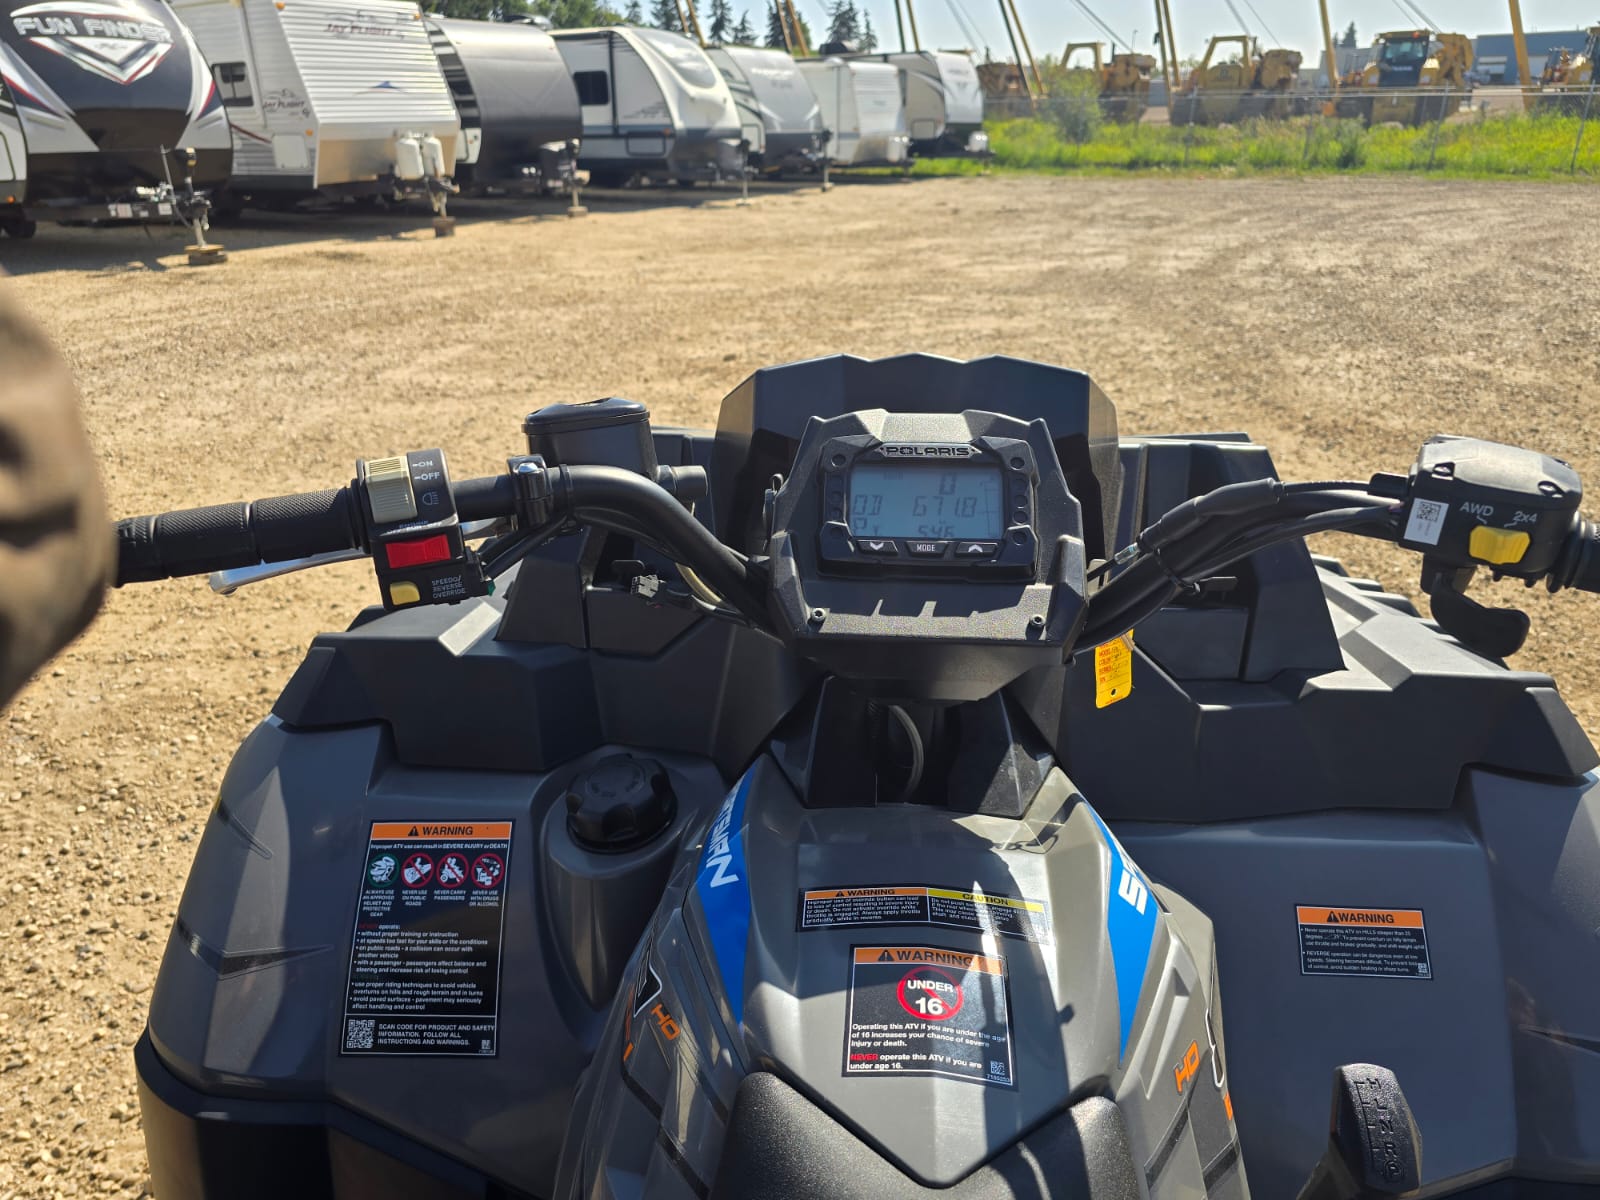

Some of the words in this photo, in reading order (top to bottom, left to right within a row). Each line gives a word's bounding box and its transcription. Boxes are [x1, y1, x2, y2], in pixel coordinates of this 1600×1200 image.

[13, 16, 78, 36] FUN
[83, 19, 174, 43] FINDER
[885, 447, 970, 456] POLARIS
[418, 460, 433, 468] ON
[421, 472, 440, 481] OFF
[1460, 501, 1494, 516] AWD
[1513, 511, 1538, 523] 2x4
[916, 543, 935, 552] MODE
[432, 575, 462, 586] SPEEDO/
[432, 588, 466, 599] OVERRIDE
[423, 826, 473, 836] WARNING
[962, 893, 1009, 906] CAUTION
[1338, 913, 1394, 924] WARNING
[897, 951, 973, 966] WARNING
[907, 980, 954, 993] UNDER
[916, 997, 943, 1015] 16
[965, 1039, 989, 1047] severe
